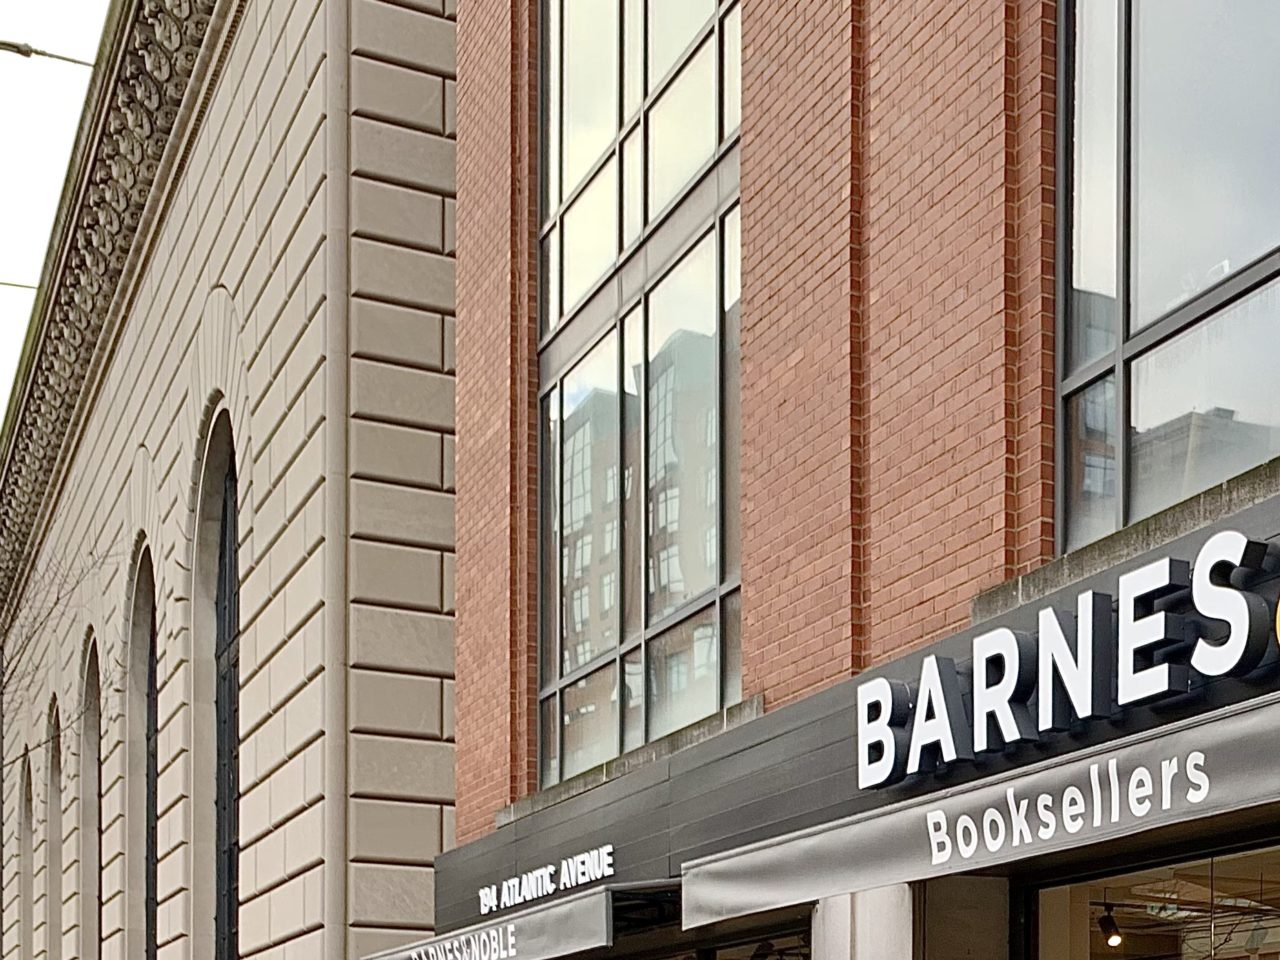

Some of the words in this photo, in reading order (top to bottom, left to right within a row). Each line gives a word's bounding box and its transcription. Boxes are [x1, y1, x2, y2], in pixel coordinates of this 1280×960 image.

[926, 750, 1211, 866] Booksellers
[479, 885, 498, 915] 194
[500, 865, 556, 910] ATLANTIC
[560, 844, 615, 890] AVENUE
